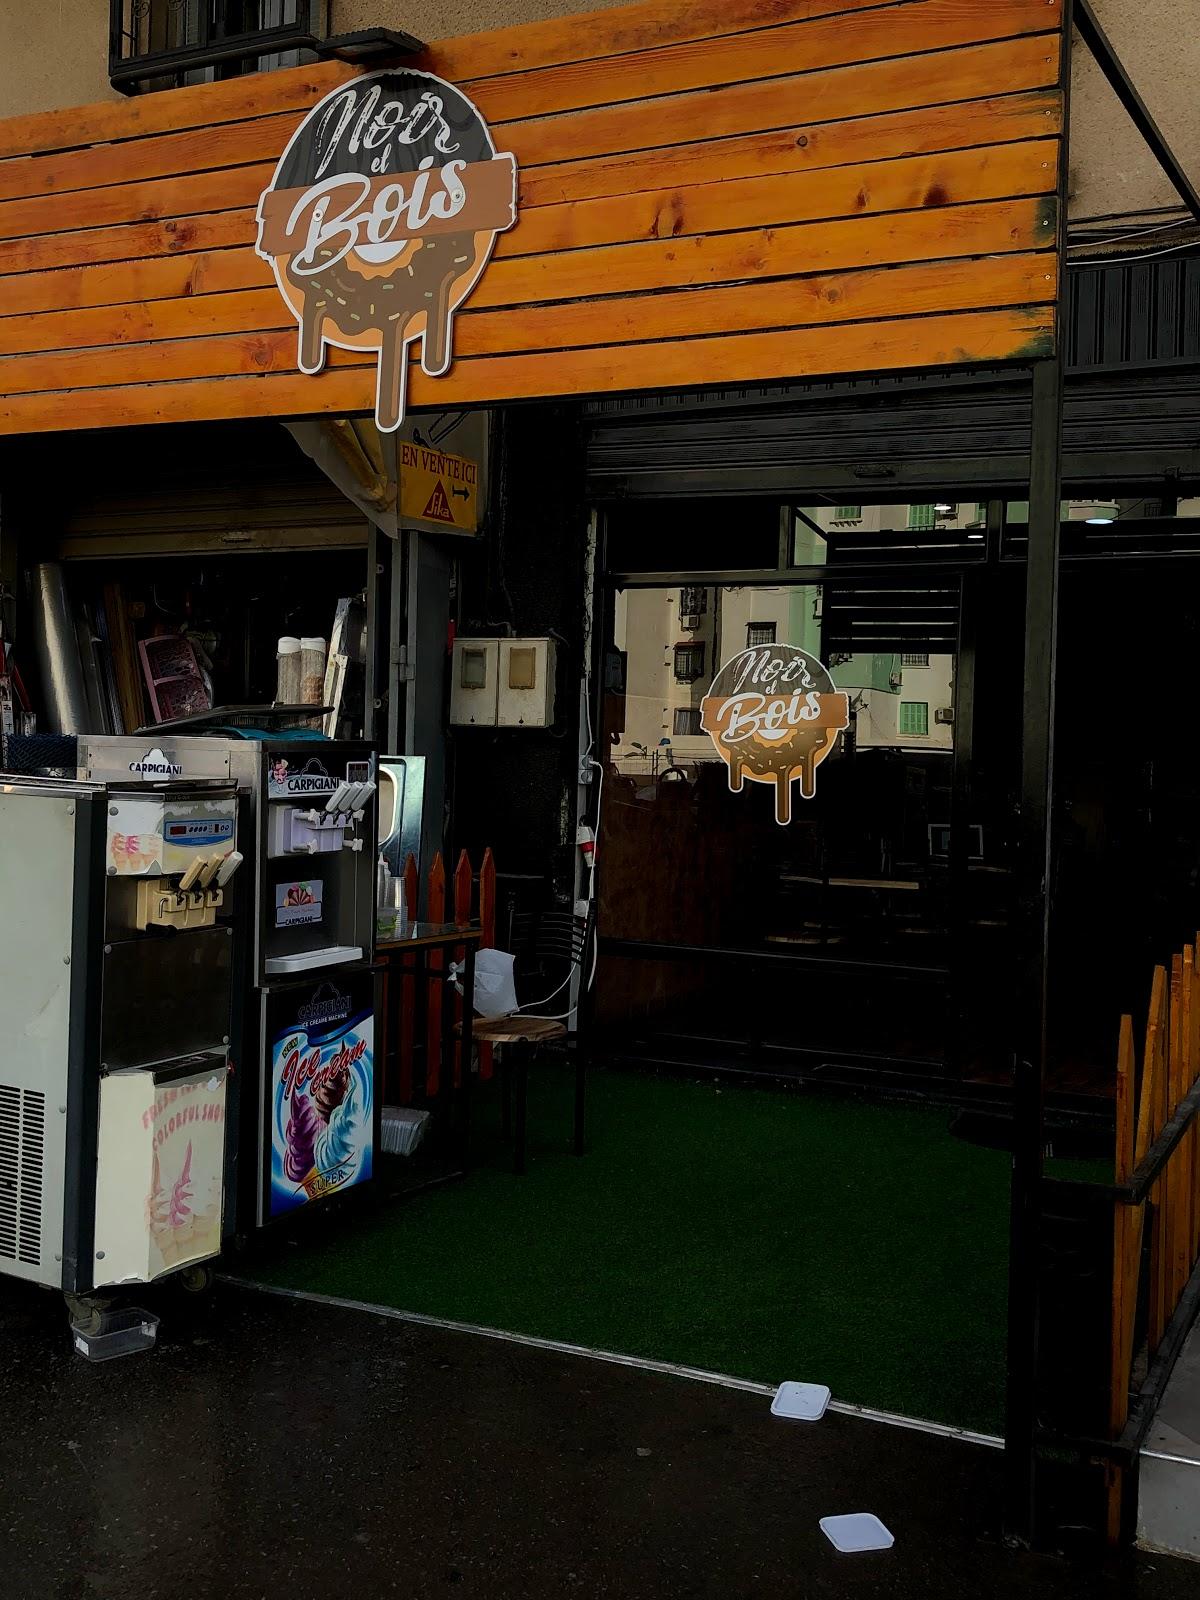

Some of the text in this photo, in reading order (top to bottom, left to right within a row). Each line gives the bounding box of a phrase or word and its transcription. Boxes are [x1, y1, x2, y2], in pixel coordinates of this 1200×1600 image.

[314, 85, 460, 179] Noir
[286, 156, 467, 276] Bois
[402, 445, 476, 484] EN VENTE ICI
[426, 492, 450, 518] Sika
[732, 650, 816, 694] Noir
[716, 688, 820, 742] Bois
[129, 762, 182, 775] CARPIGIANI
[288, 776, 340, 791] CARPIGIANI
[310, 1169, 344, 1194] SUPER
